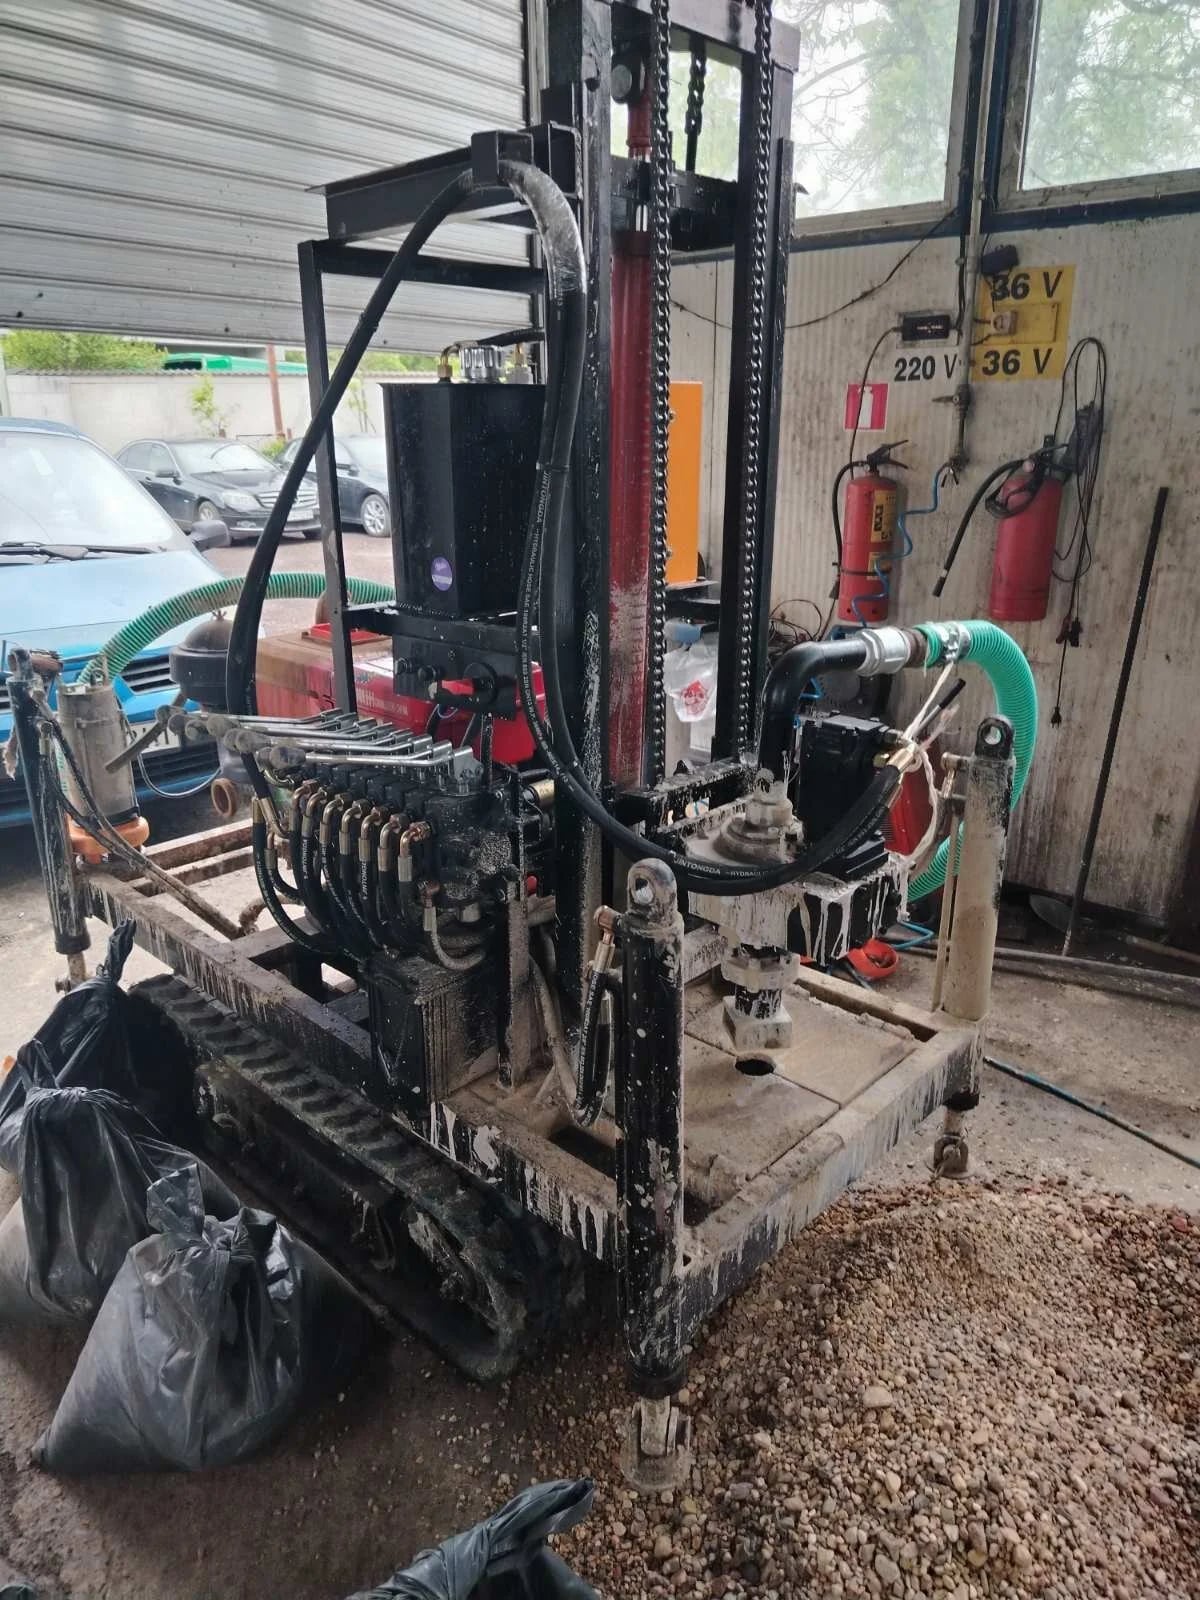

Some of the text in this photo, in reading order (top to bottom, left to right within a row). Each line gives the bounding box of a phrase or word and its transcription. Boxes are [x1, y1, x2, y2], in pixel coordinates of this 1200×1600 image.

[993, 271, 1063, 300] 36 V
[894, 354, 958, 382] 220 V
[982, 348, 1053, 376] 36 V
[537, 471, 551, 523] JINTONGDA
[674, 858, 720, 875] JINTONGDA
